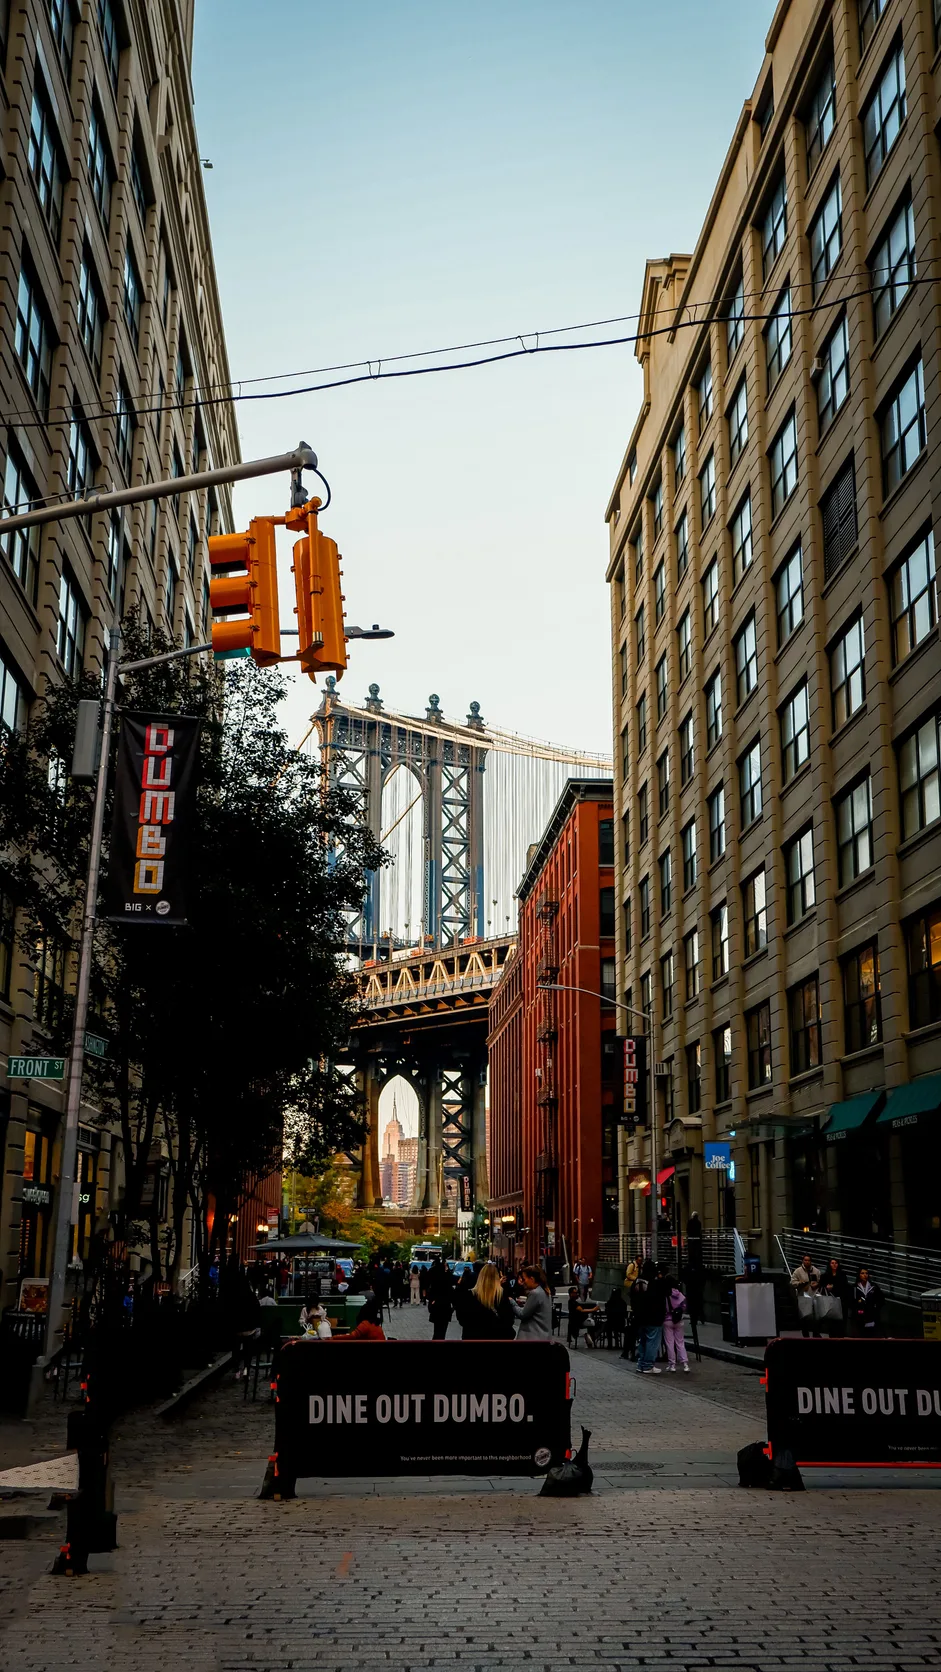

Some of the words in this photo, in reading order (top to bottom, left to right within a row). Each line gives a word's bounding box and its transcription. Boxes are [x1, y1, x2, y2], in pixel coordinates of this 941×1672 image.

[133, 722, 175, 895] DUMBO
[124, 902, 142, 912] BIG
[10, 1059, 50, 1077] FRONT
[54, 1060, 64, 1070] ST
[623, 1038, 638, 1113] DUMBO
[705, 1161, 731, 1169] Coffee
[711, 1154, 726, 1163] Joe
[308, 1394, 368, 1424] DINE
[375, 1393, 425, 1424] OUT
[433, 1393, 534, 1423] DUMBO.
[797, 1386, 856, 1415] DINE
[861, 1387, 909, 1416] OUT
